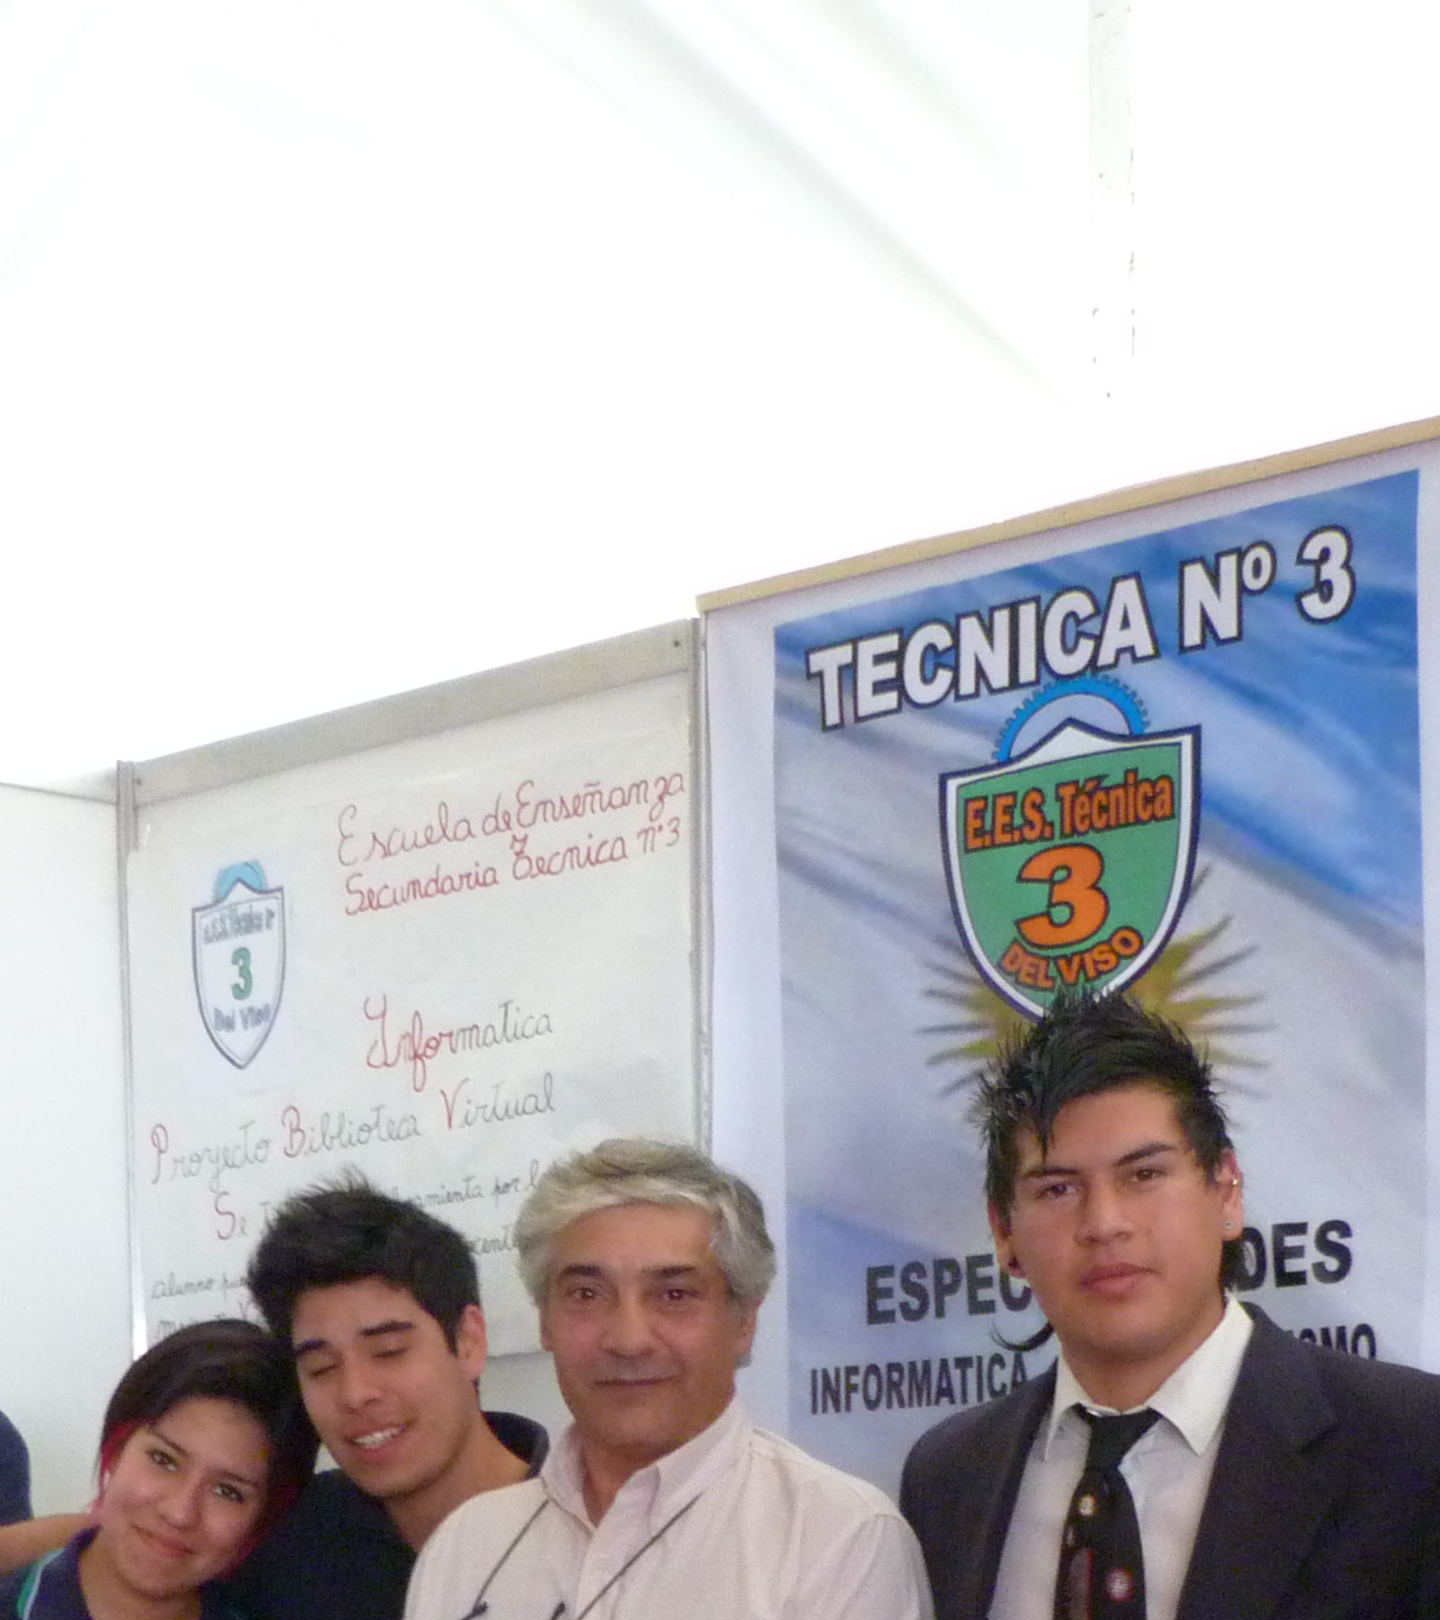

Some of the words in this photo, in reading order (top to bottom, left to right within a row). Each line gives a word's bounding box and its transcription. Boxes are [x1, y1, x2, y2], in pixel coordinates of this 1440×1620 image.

[807, 573, 1160, 730] TECNICA
[1294, 526, 1356, 625] 3
[338, 801, 474, 866] Escuela
[482, 792, 512, 837] de
[515, 772, 686, 829] Enseñanza
[964, 787, 1055, 854] E.E.S.
[1055, 768, 1177, 839] Técnica
[345, 864, 499, 916] Secundaria
[1014, 842, 1110, 950] 3
[231, 947, 253, 1001] 3
[998, 937, 1057, 990] DEL
[1056, 926, 1144, 985] VISO
[364, 994, 554, 1093] Informatica
[150, 1121, 273, 1193] Proyecto
[282, 1104, 422, 1159] Biblioteca
[439, 1072, 556, 1130] Virtual
[810, 1352, 1028, 1416] INFORMATICA
